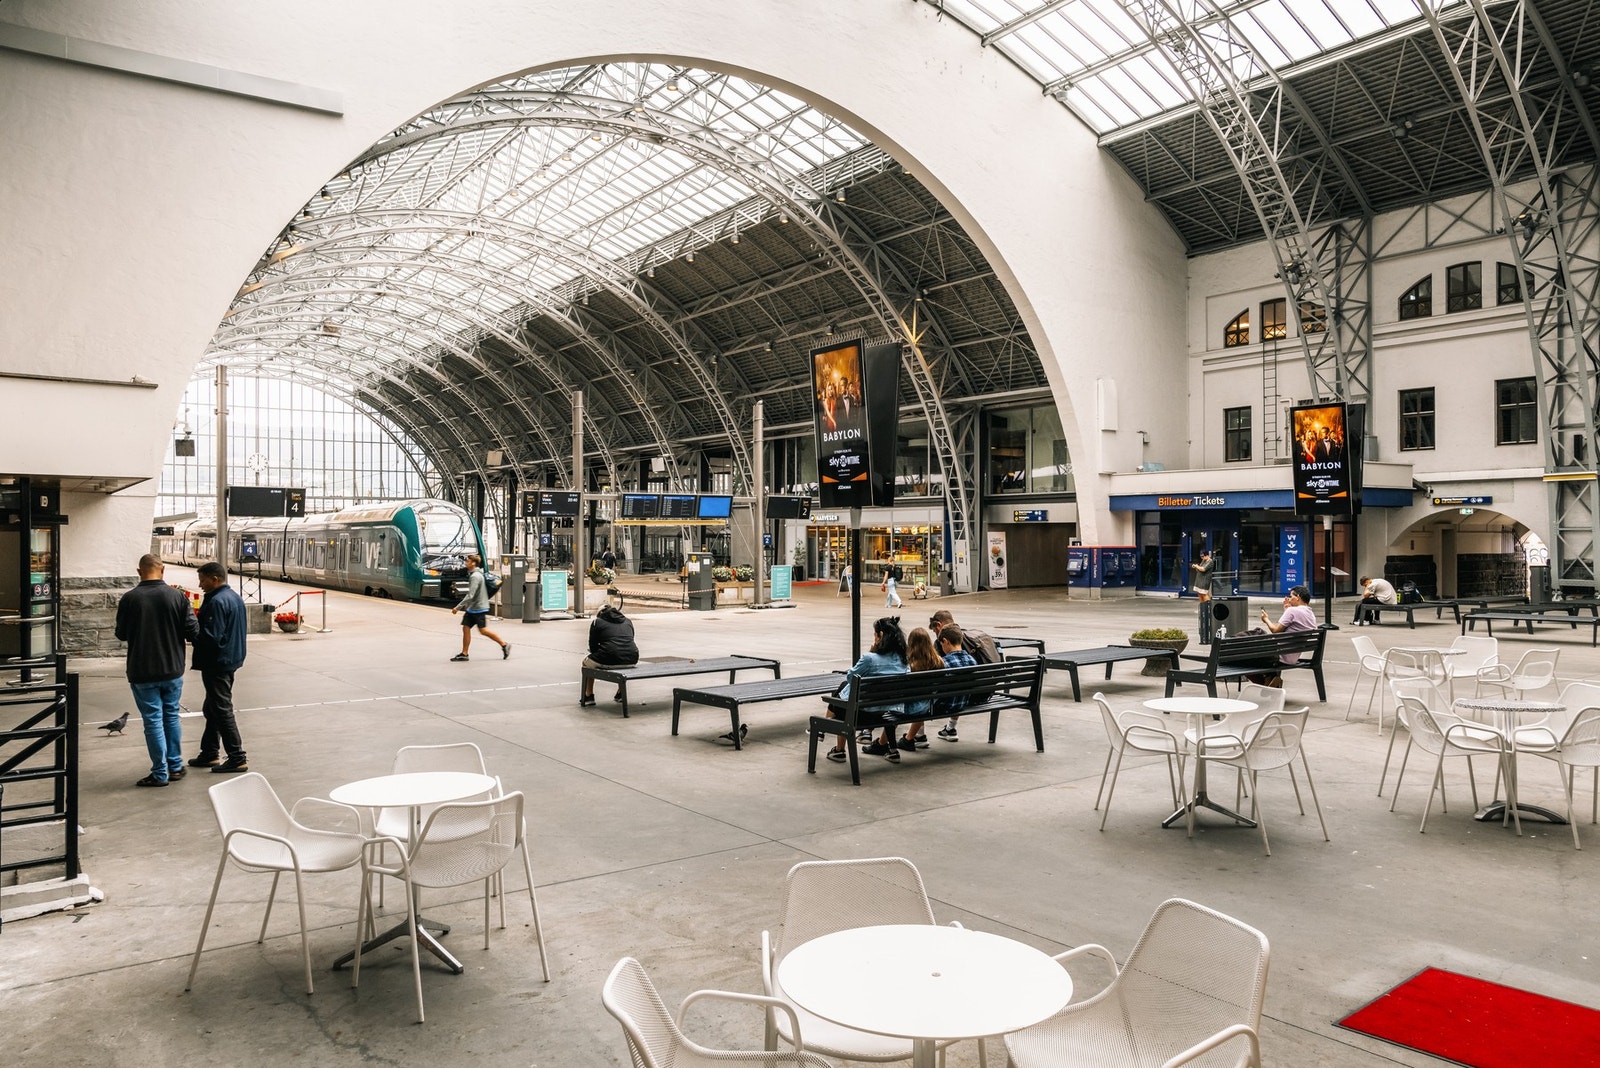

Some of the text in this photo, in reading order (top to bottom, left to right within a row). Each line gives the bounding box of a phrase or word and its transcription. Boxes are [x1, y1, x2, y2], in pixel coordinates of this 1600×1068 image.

[824, 428, 860, 442] BABYLON
[1301, 462, 1341, 470] BABYLON
[1158, 495, 1225, 506] Billetter Tickets
[291, 502, 299, 512] 4
[527, 504, 533, 512] 3
